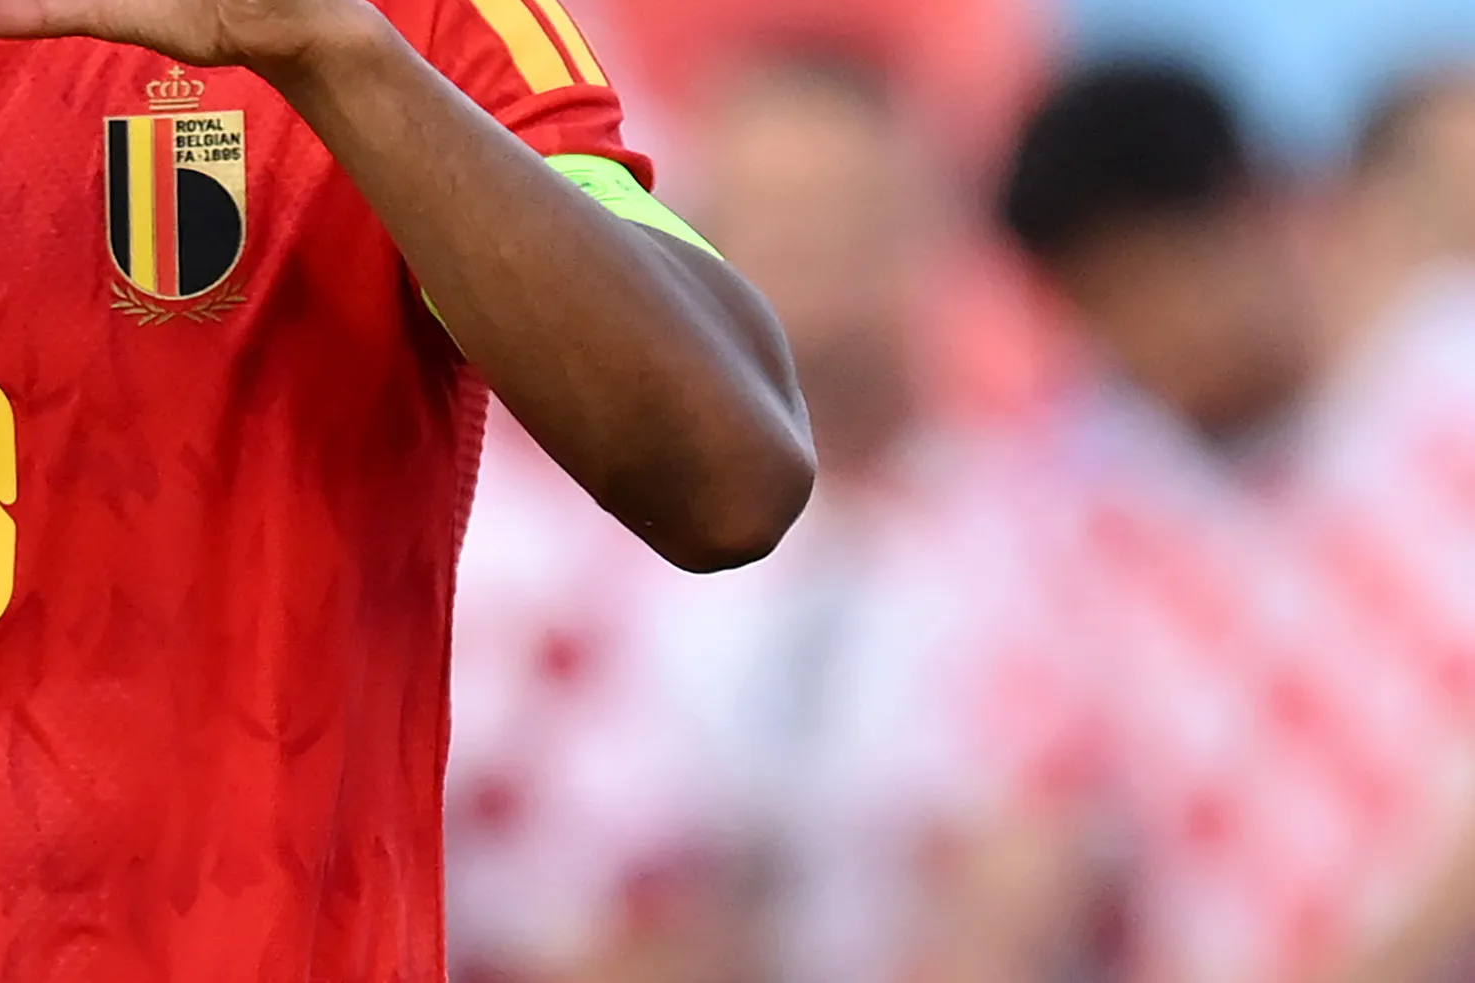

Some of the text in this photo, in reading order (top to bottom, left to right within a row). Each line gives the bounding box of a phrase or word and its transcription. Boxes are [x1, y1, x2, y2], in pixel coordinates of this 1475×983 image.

[176, 119, 223, 133] ROYAL
[176, 133, 241, 148] BELGIAN
[176, 150, 195, 163] FA
